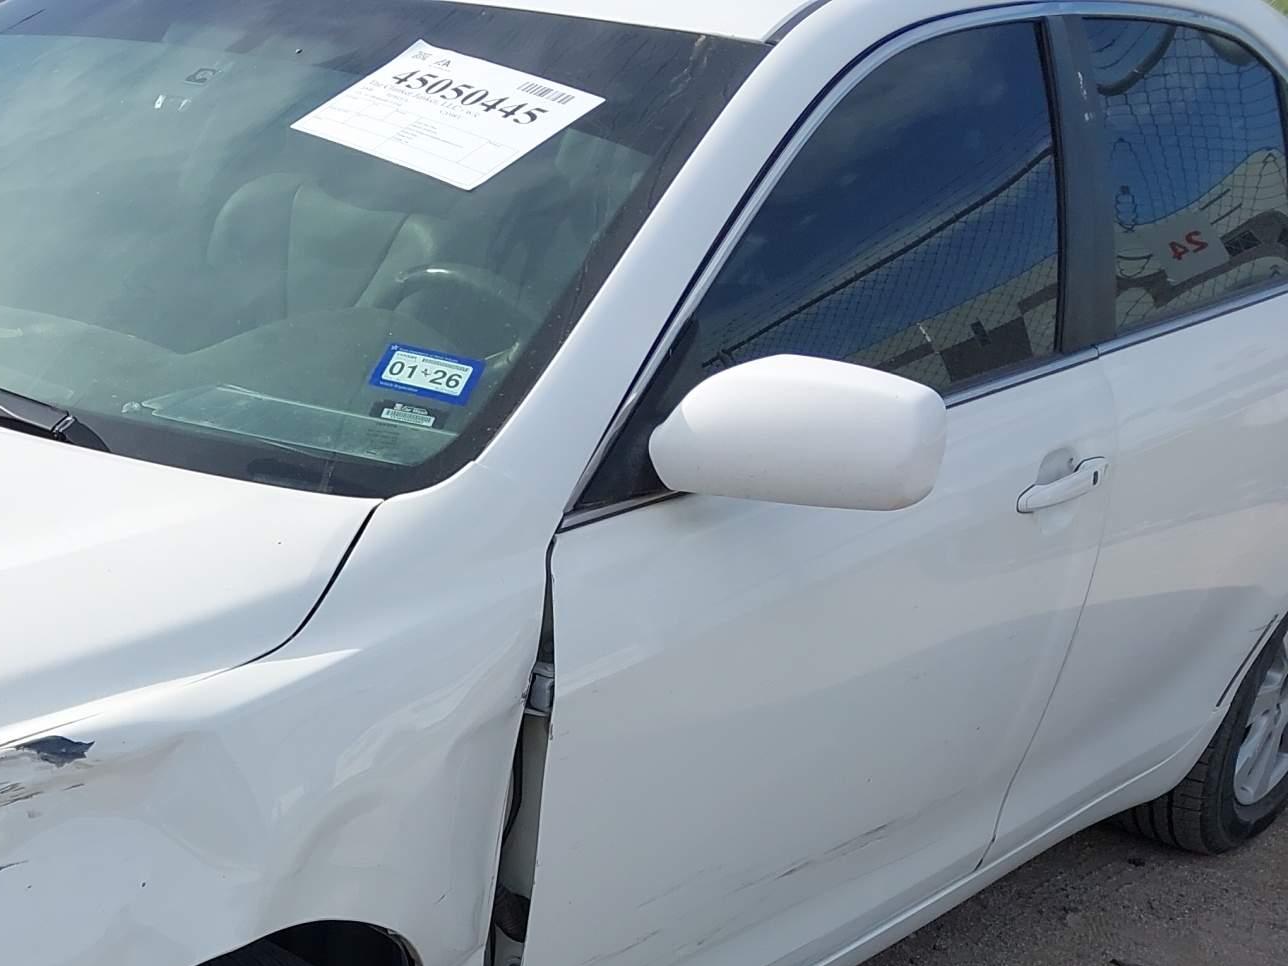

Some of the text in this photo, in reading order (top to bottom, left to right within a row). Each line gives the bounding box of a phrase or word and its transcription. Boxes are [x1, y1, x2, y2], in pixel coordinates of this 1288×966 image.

[392, 70, 549, 126] 45050445
[389, 361, 418, 379] 01
[429, 369, 463, 389] 26
